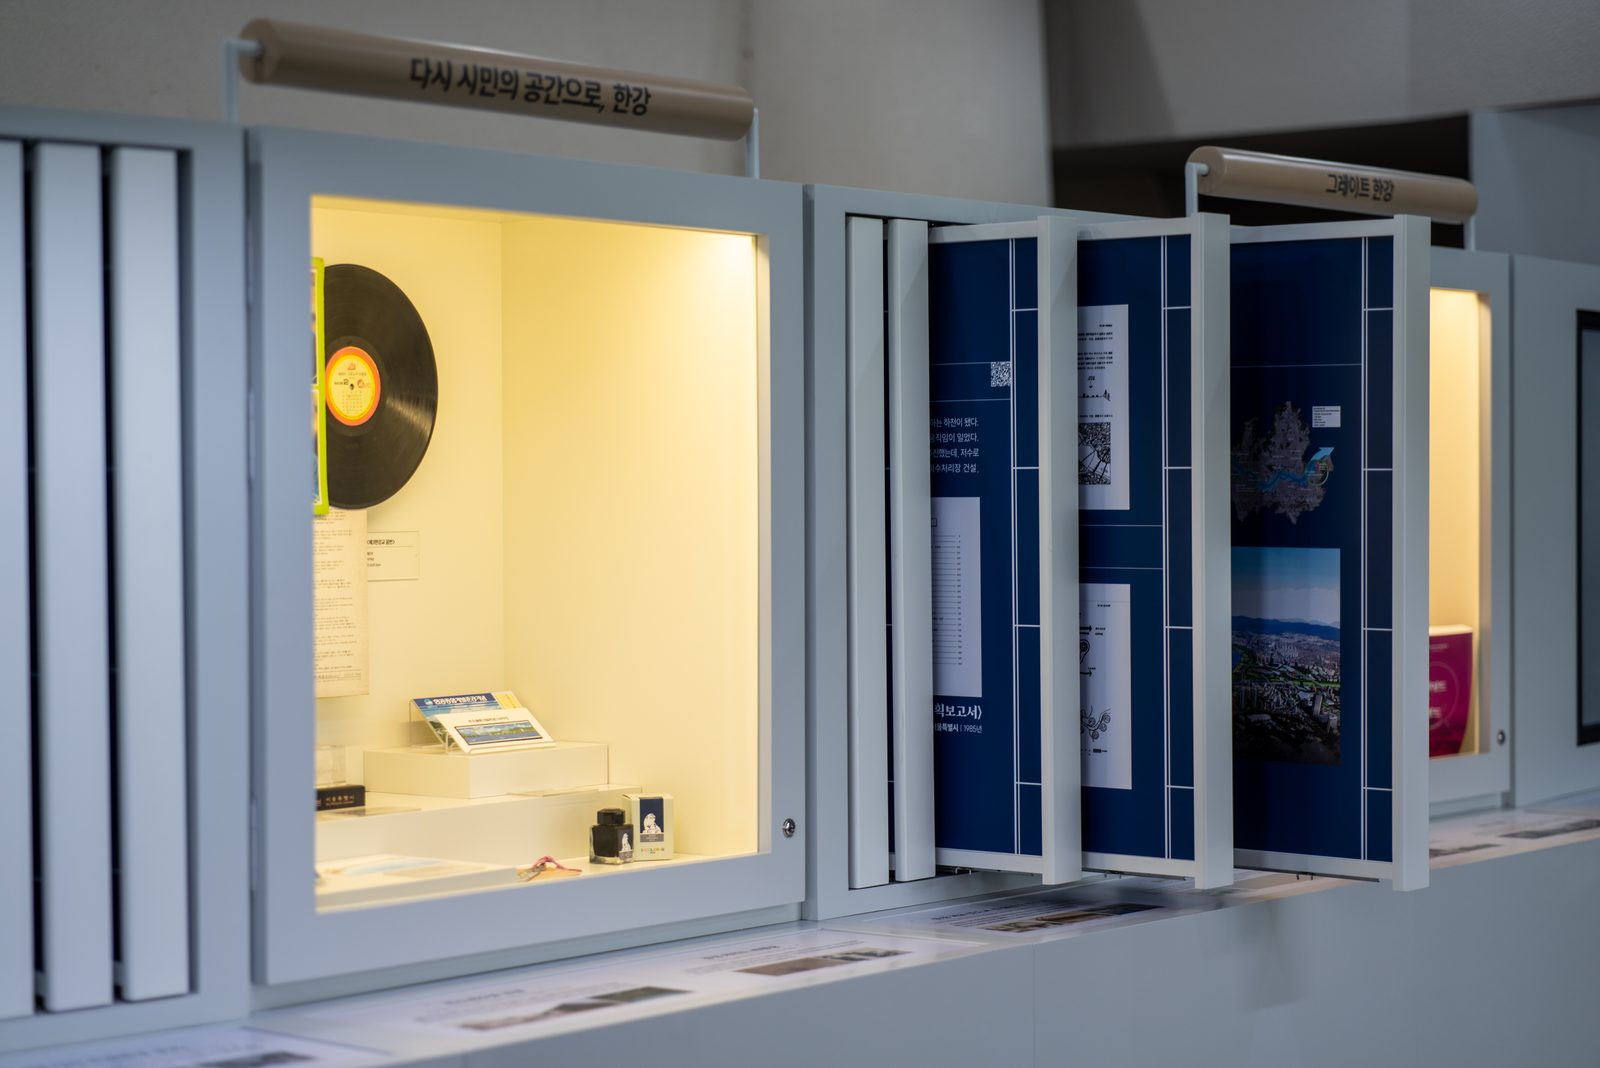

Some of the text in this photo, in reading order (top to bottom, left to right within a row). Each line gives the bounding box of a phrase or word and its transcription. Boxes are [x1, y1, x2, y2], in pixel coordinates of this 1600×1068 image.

[410, 58, 651, 116] 다시 시민의 공간으로, 한강
[1326, 174, 1394, 202] 그레이트 한강
[944, 417, 963, 428] 하천이
[964, 417, 979, 428] 됐다.
[957, 432, 979, 443] 일었다.
[960, 448, 979, 458] 저수로
